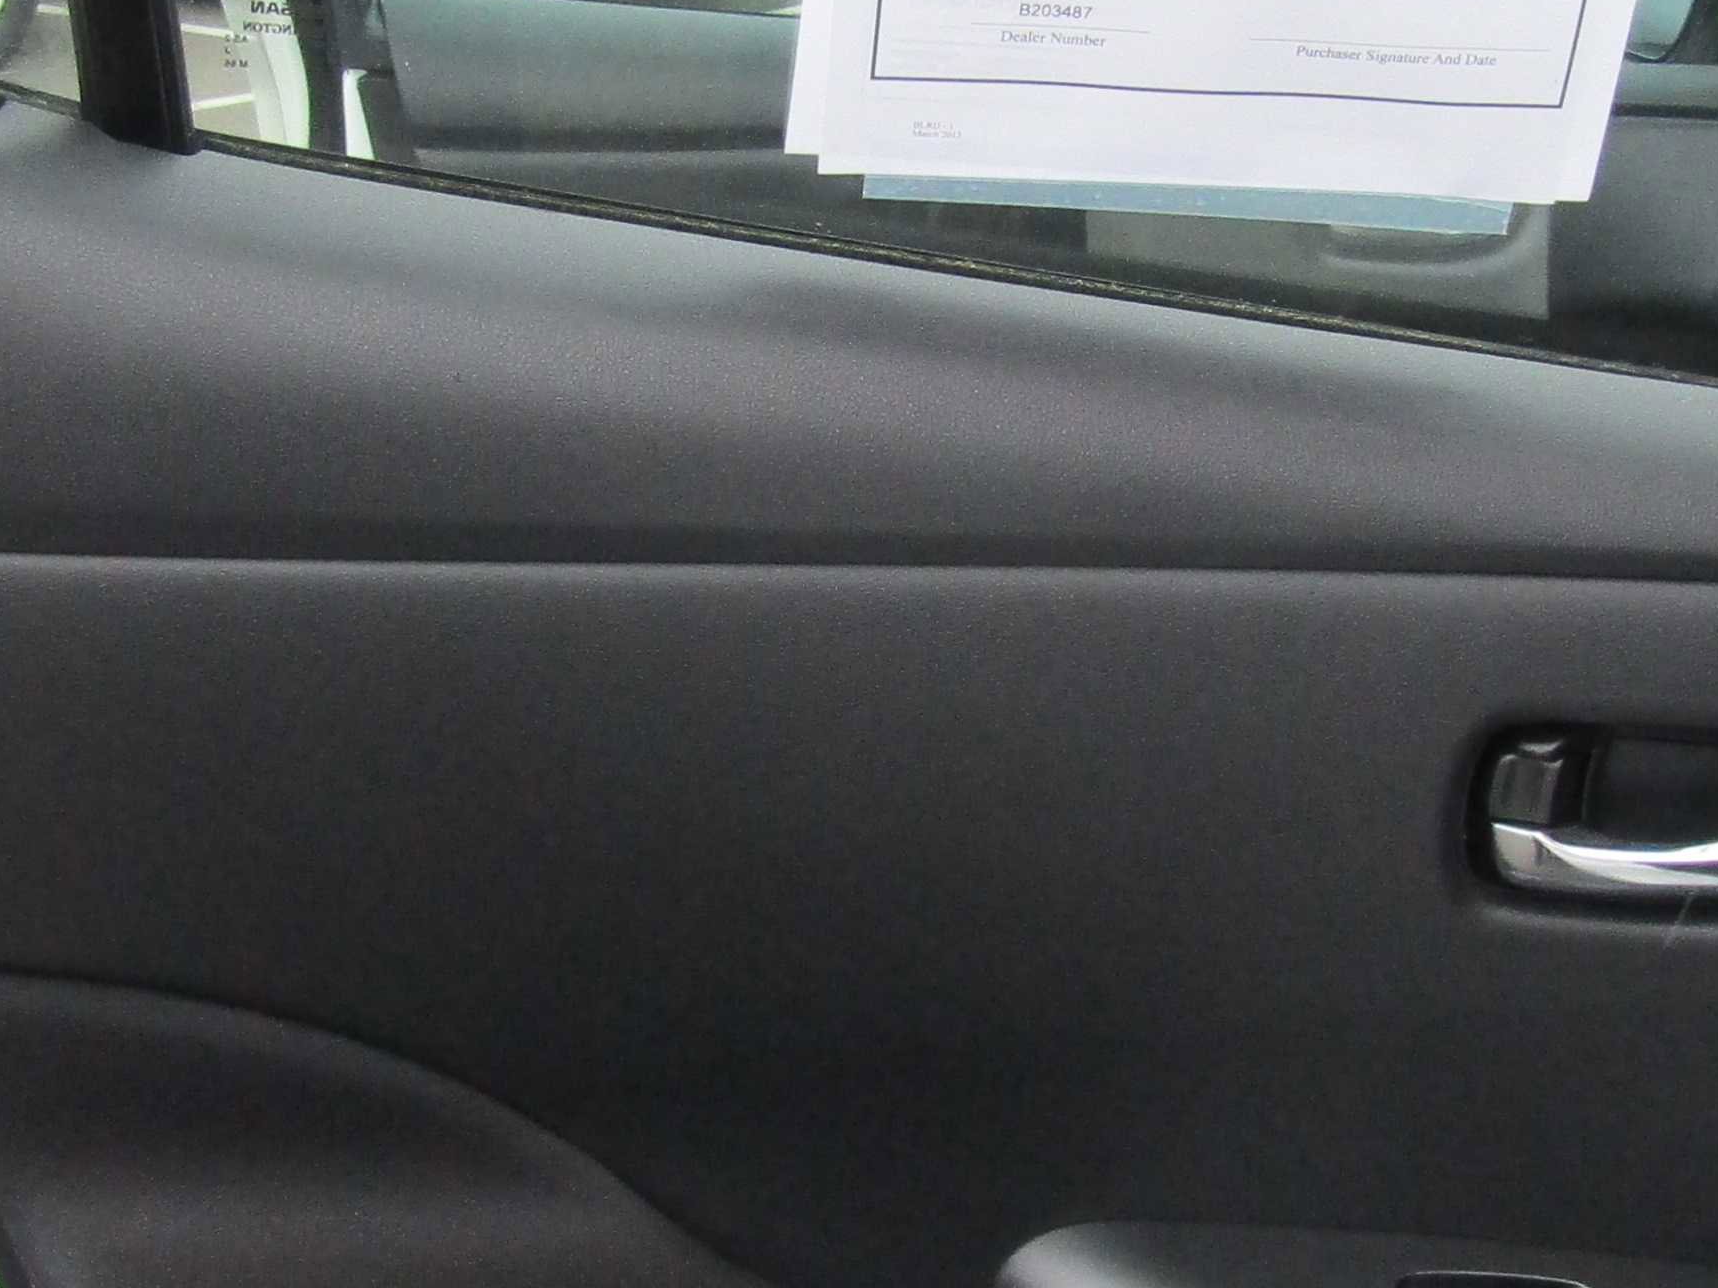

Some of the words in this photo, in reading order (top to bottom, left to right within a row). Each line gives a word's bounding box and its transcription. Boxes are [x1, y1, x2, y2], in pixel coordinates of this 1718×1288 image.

[1019, 3, 1093, 19] B203487
[1000, 30, 1047, 44] Dealer
[1050, 32, 1107, 47] Number
[1296, 44, 1363, 60] Purchaser
[1365, 48, 1431, 65] Signature
[1432, 51, 1462, 65] And
[1464, 52, 1497, 66] Date
